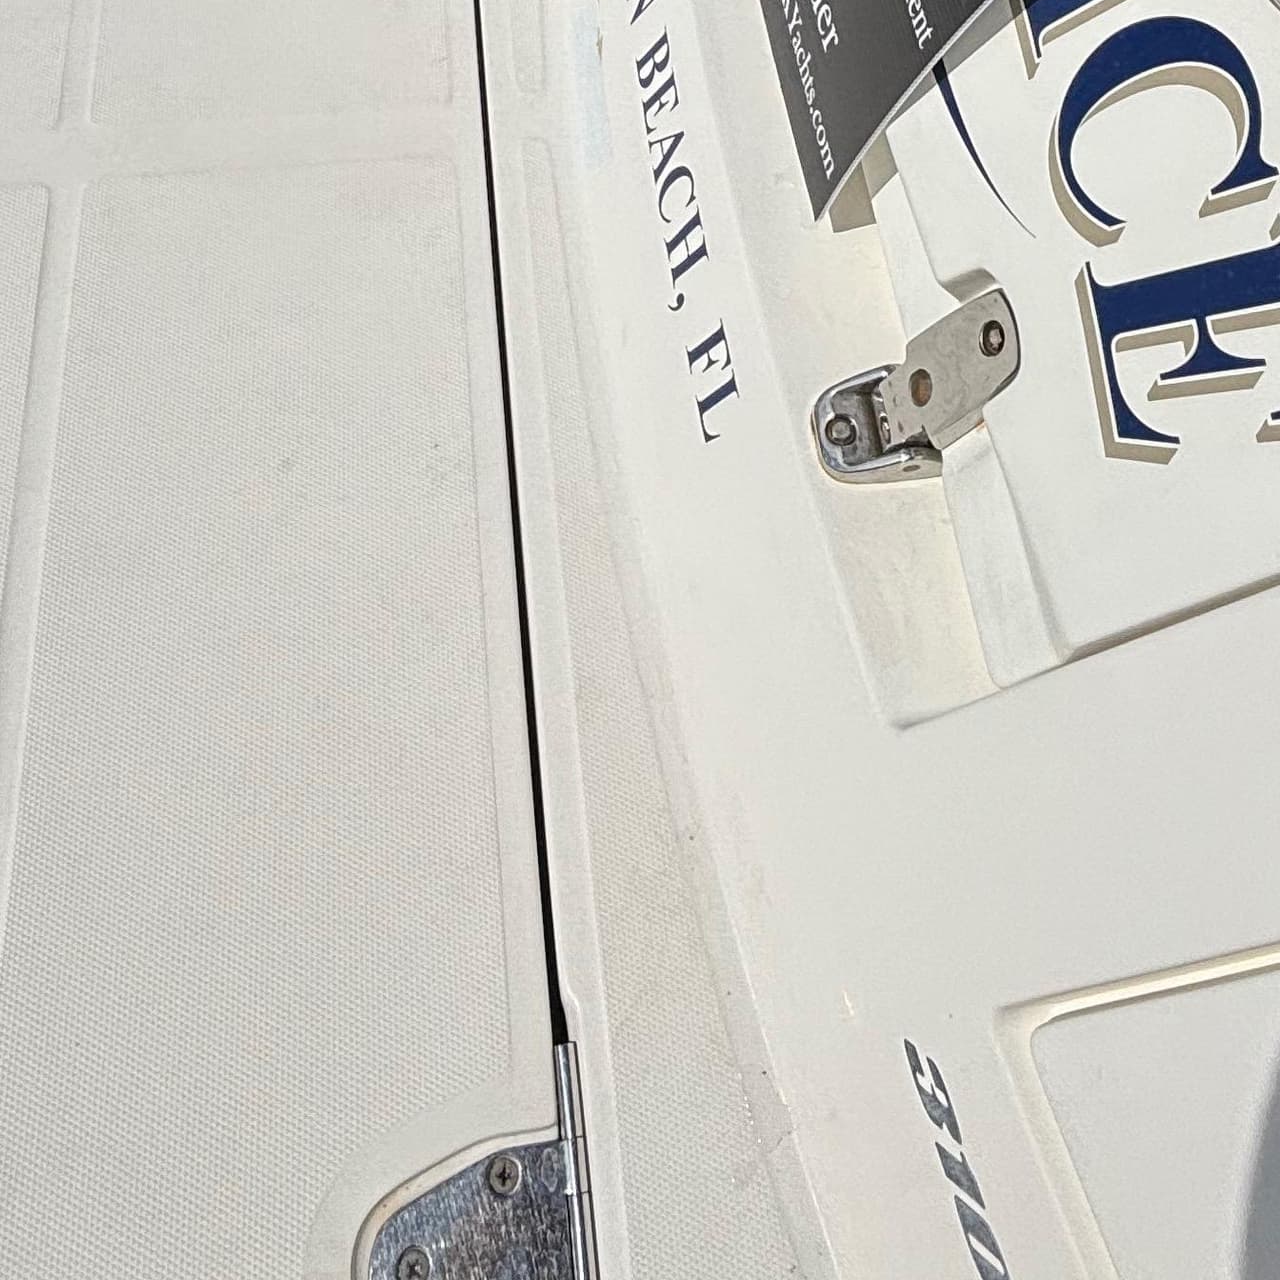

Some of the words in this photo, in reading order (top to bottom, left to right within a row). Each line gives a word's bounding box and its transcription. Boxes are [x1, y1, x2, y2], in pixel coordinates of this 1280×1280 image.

[634, 25, 710, 312] BEACH,
[685, 317, 740, 444] FL
[904, 1038, 1013, 1280] 310
